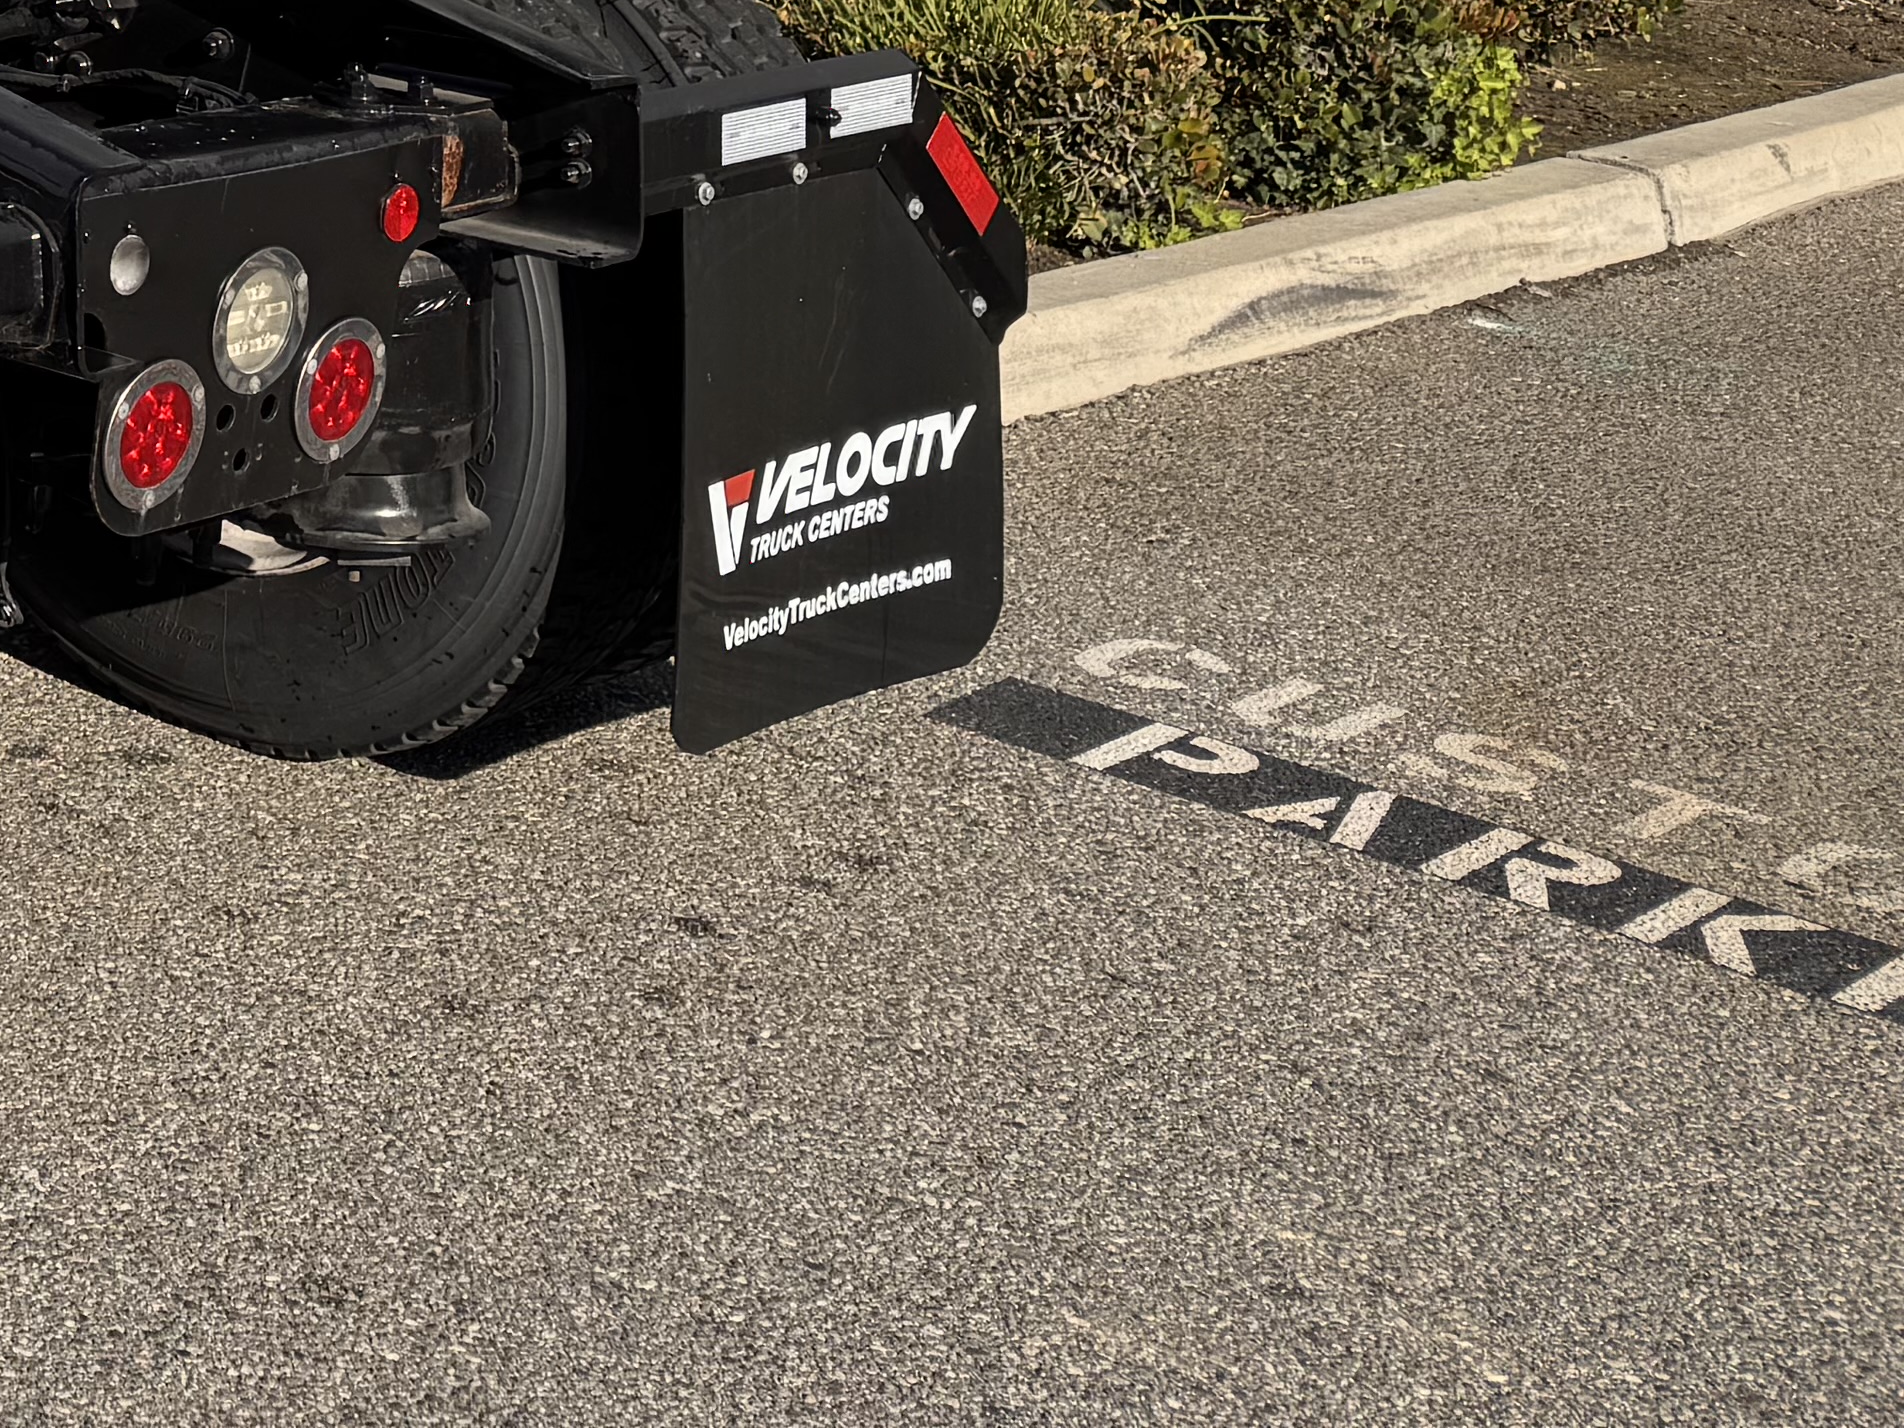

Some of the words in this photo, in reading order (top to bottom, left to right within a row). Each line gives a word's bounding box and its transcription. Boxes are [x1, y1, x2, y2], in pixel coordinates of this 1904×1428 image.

[755, 404, 977, 525] VELOCITY
[750, 525, 805, 564] TRUCK
[807, 494, 890, 543] CENTERS
[723, 557, 952, 651] VelocityTruckCenters.com
